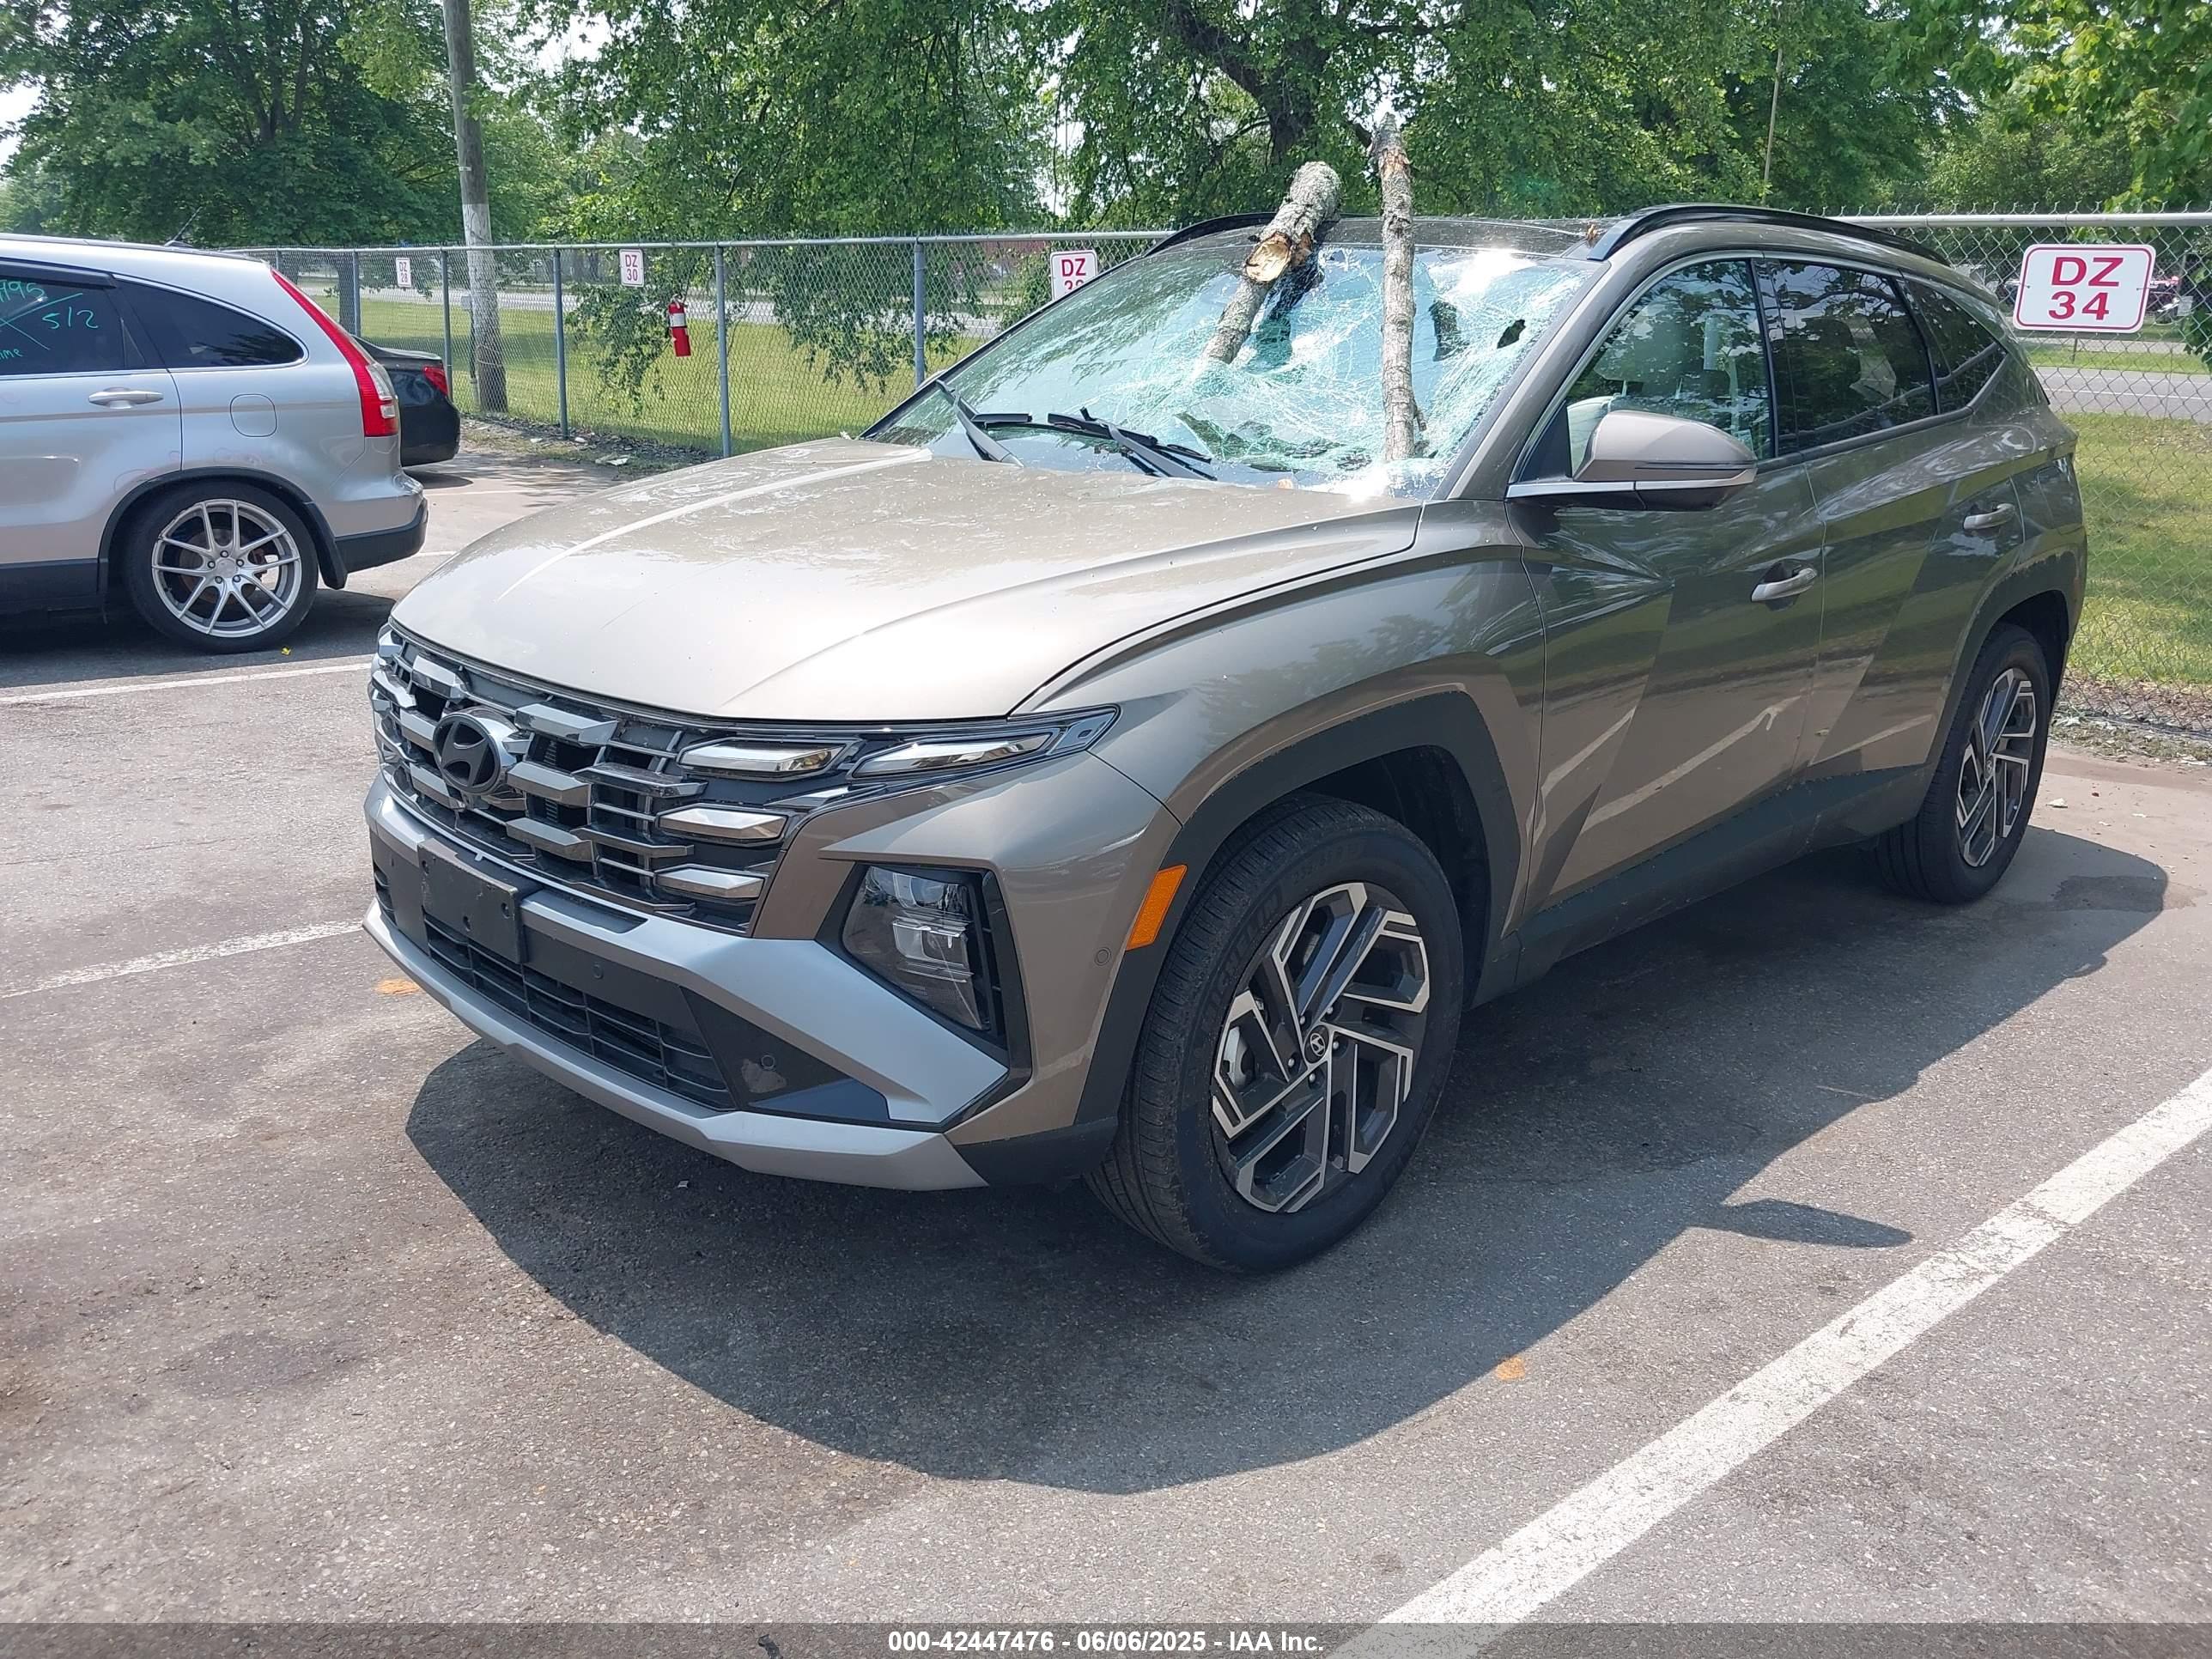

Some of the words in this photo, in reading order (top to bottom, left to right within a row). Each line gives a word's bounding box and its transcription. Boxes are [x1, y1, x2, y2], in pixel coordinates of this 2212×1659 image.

[398, 261, 408, 272] DZ
[625, 254, 638, 267] DZ
[1060, 258, 1087, 277] DZ
[627, 268, 638, 282] 30
[2051, 256, 2124, 288] DZ
[2048, 290, 2110, 321] 34
